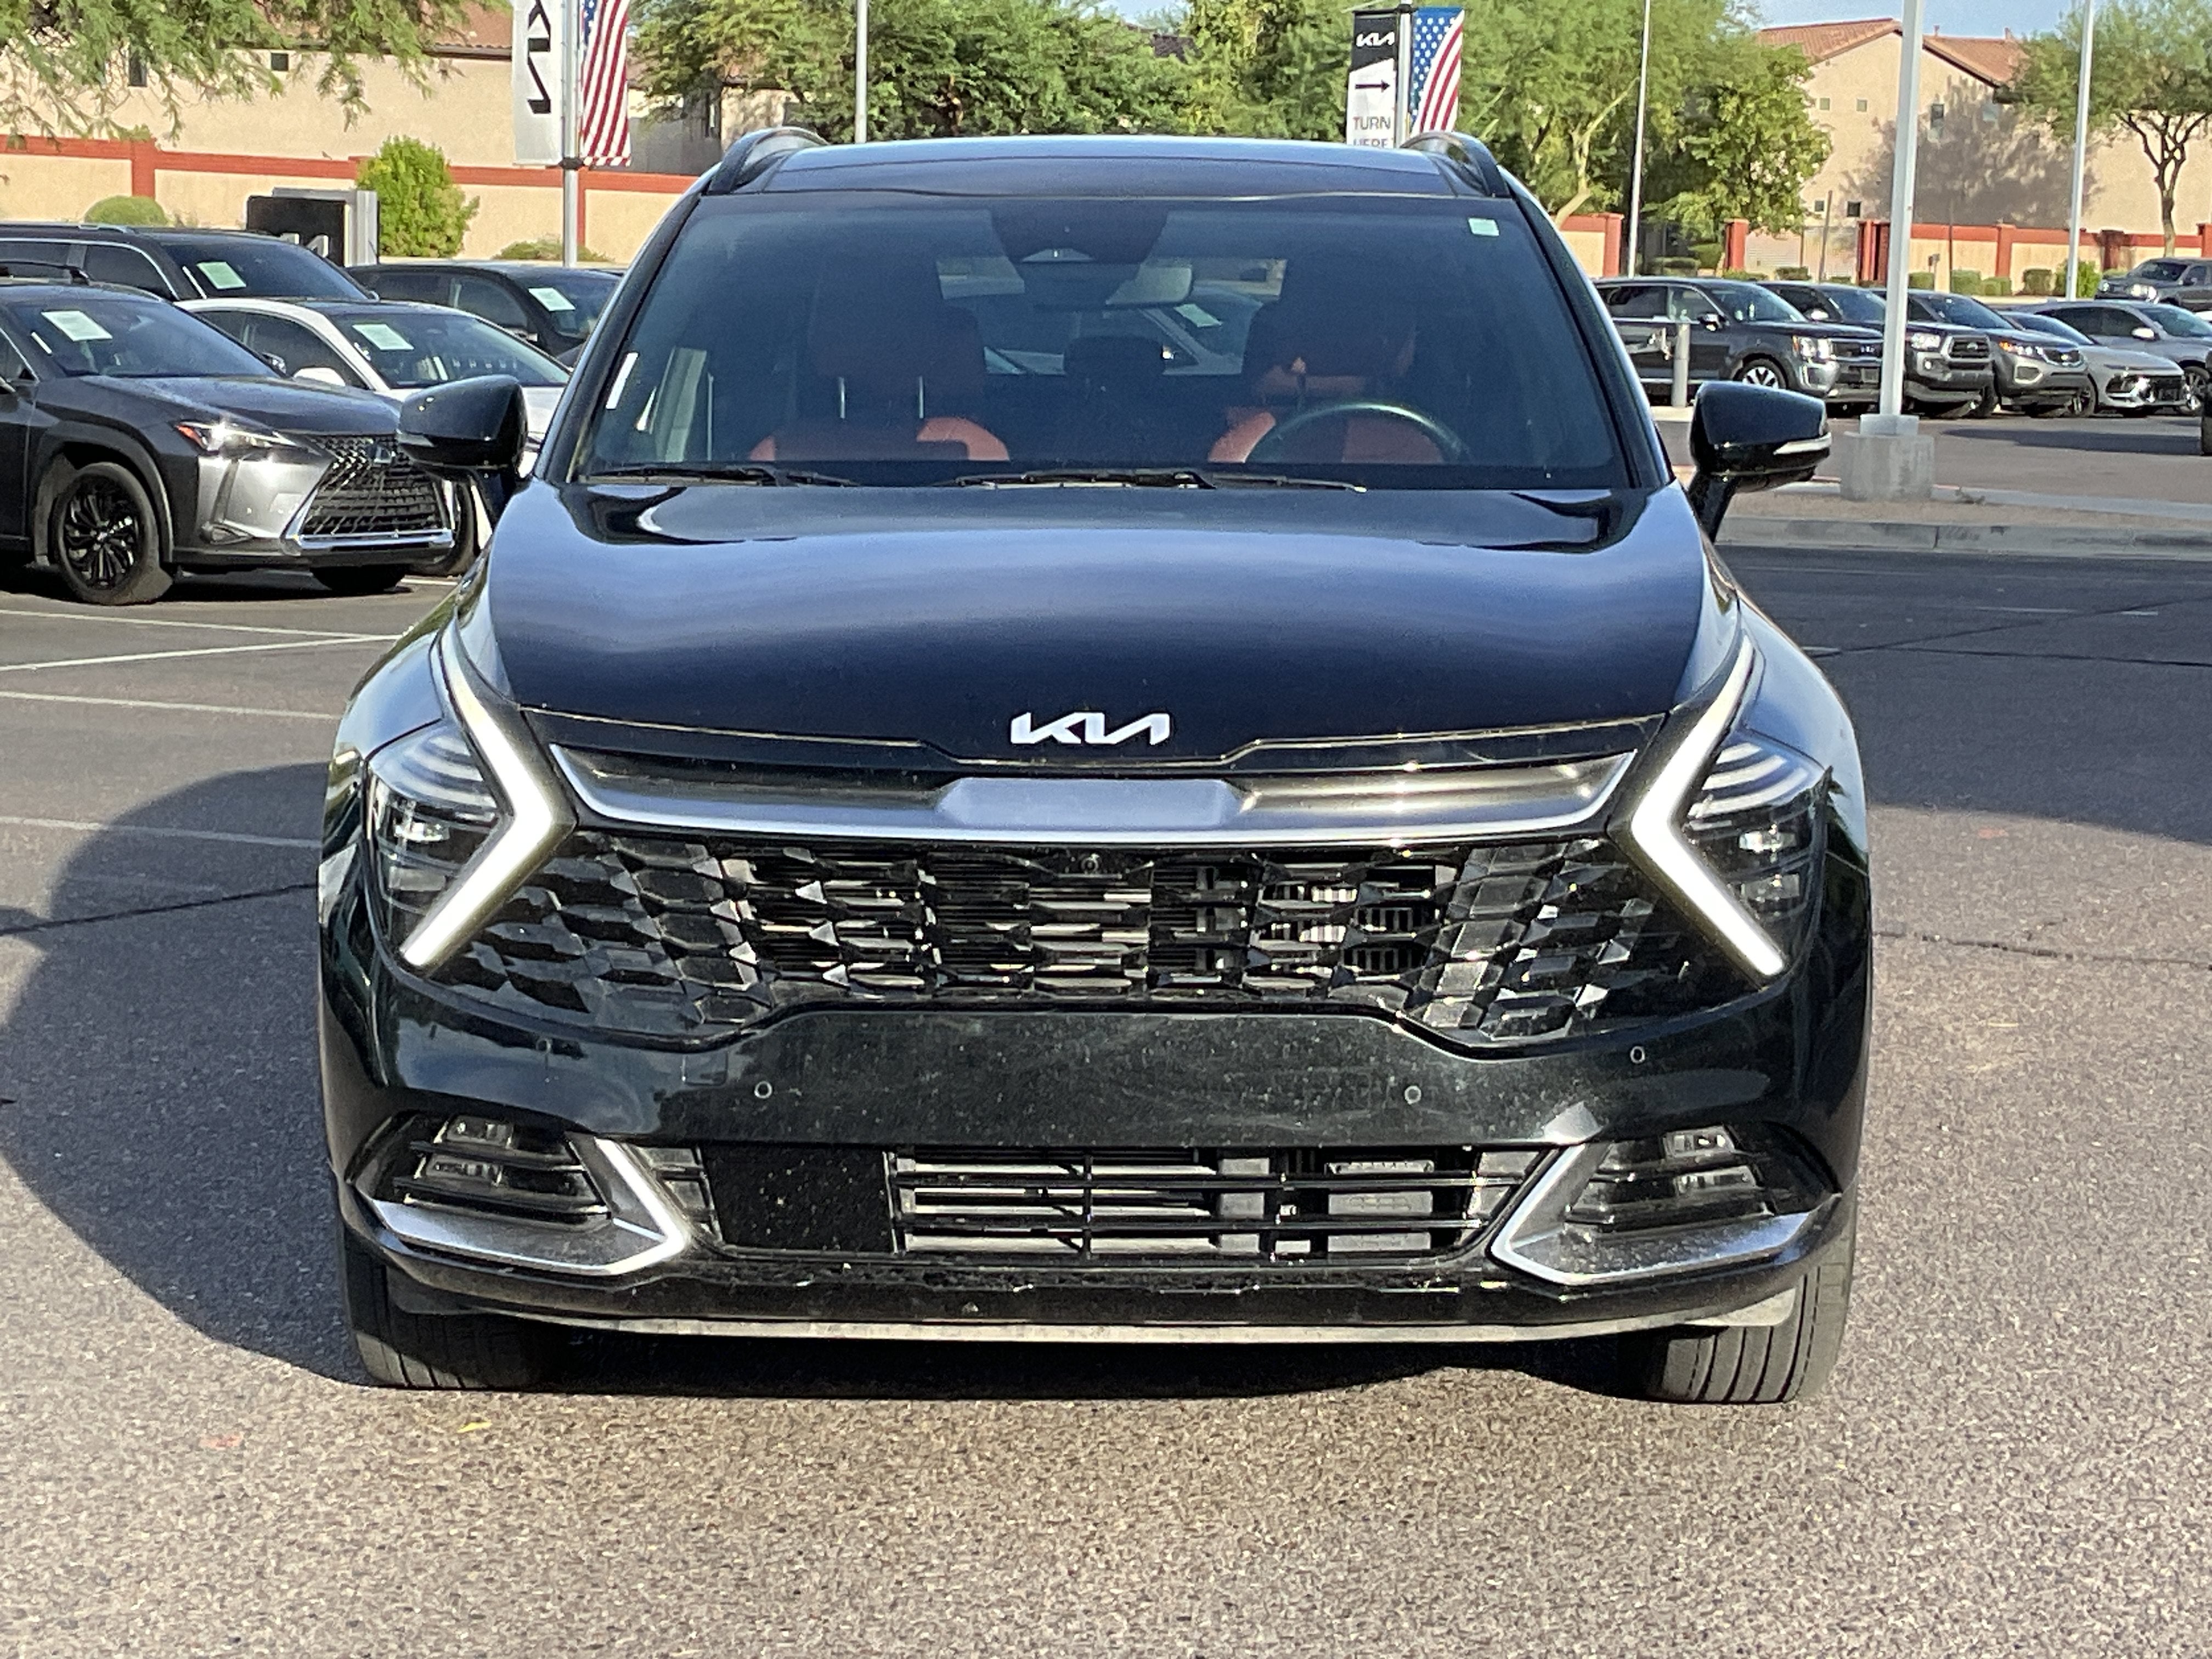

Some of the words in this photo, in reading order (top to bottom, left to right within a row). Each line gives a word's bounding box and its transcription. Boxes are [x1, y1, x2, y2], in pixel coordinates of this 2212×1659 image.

[1356, 31, 1395, 47] KIA
[1353, 116, 1391, 130] TURN
[1011, 712, 1170, 745] KIA
